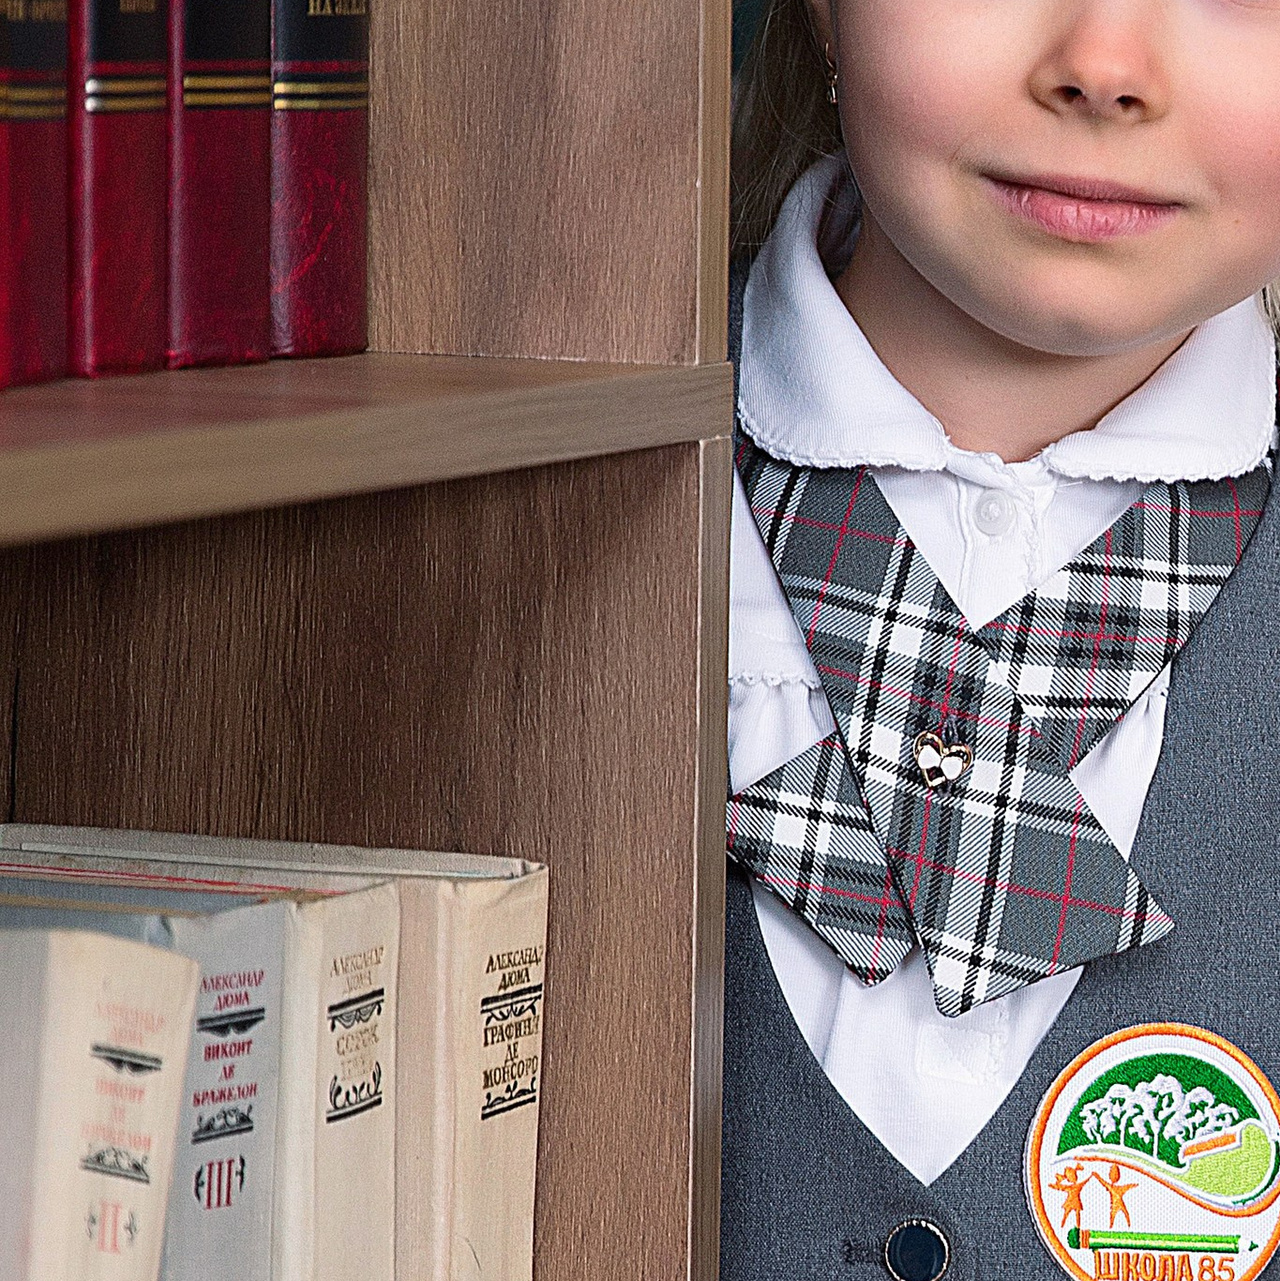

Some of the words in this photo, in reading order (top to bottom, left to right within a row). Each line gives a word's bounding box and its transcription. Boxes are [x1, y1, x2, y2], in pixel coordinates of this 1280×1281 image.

[200, 969, 265, 994] АЛЕКСАНДР
[498, 967, 531, 993] ДЮМА
[213, 990, 250, 1012] ДЮМА
[204, 1039, 253, 1063] ВИКОНТ
[504, 1041, 519, 1065] ДЕ
[482, 1055, 539, 1090] МОНСОРО
[192, 1082, 258, 1108] БРАЖЕЛОН
[204, 1158, 235, 1210] III
[97, 1199, 122, 1255] II
